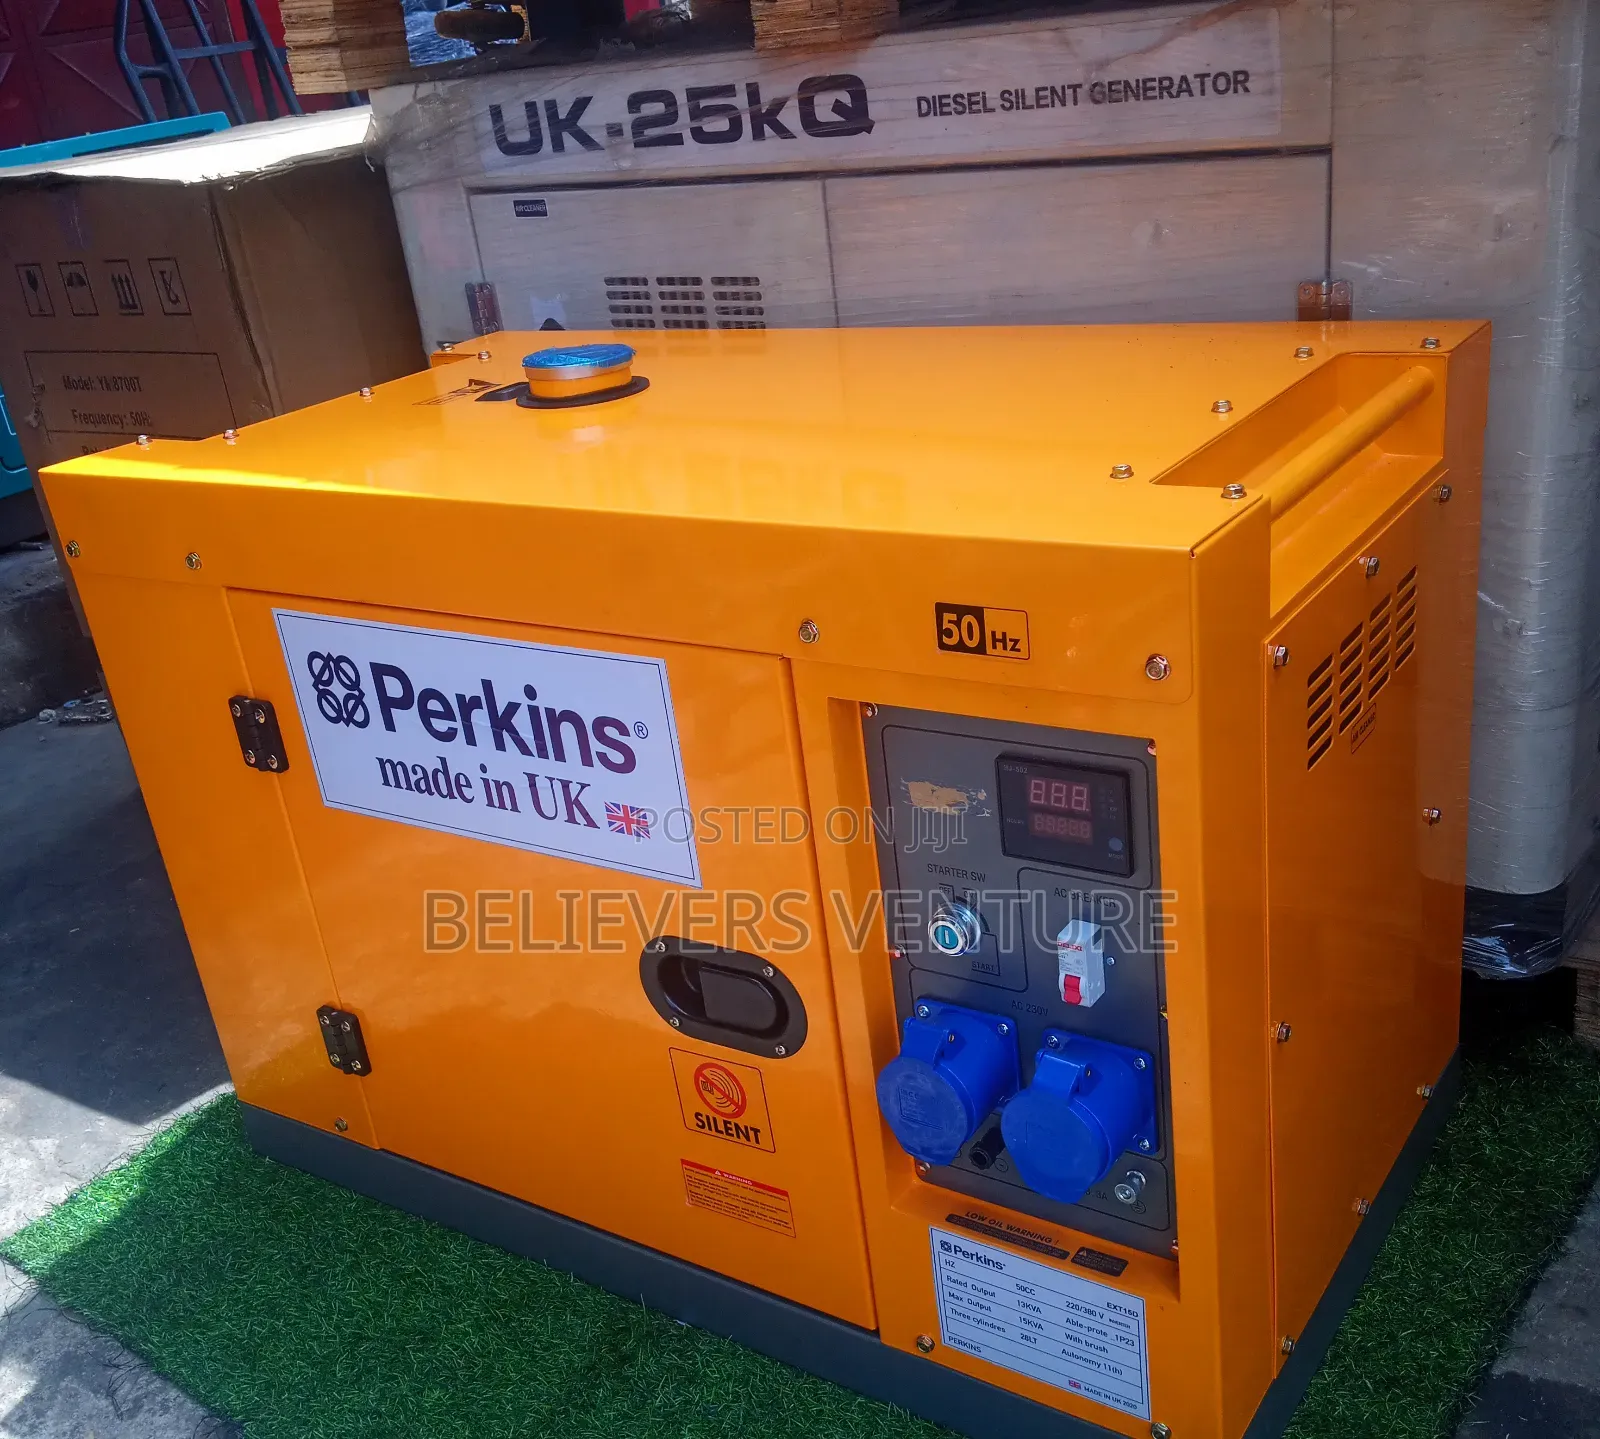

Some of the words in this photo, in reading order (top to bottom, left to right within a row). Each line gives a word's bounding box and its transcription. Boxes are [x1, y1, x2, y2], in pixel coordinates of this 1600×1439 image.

[917, 91, 996, 117] DIESEL
[999, 83, 1082, 111] SILENT
[1089, 69, 1251, 105] GENERATOR
[62, 375, 96, 391] Model:
[71, 408, 129, 429] Frequency:
[942, 612, 980, 648] 50
[990, 630, 1022, 653] Hz
[376, 756, 475, 804] made
[479, 763, 520, 814] in
[523, 771, 600, 830] UK
[927, 863, 968, 880] STARTER
[970, 871, 986, 883] SW
[1053, 887, 1067, 898] AC
[1070, 890, 1116, 908] BREAKER
[971, 960, 995, 972] START
[1011, 1000, 1024, 1011] AC
[1026, 1003, 1049, 1017] 230V
[694, 1111, 761, 1145] SILENT
[965, 1211, 988, 1222] LOW
[988, 1218, 1004, 1229] OIL
[1006, 1224, 1054, 1244] WARNING
[945, 1258, 956, 1268] HZ
[1098, 1312, 1105, 1320] V
[946, 1275, 968, 1288] Rated
[971, 1283, 996, 1298] Output
[1017, 1299, 1043, 1315] 13KVA
[948, 1291, 964, 1302] Max
[967, 1298, 992, 1313] Output
[1019, 1316, 1044, 1331] 15KVA
[1064, 1332, 1083, 1345] With
[1084, 1340, 1109, 1354] brush
[949, 1306, 971, 1320] Three
[972, 1316, 1006, 1333] cylindres
[1061, 1347, 1102, 1369] Autonomy
[948, 1335, 982, 1354] PERKINS
[1083, 1385, 1102, 1397] MADE
[1111, 1396, 1122, 1404] UK
[1122, 1400, 1138, 1410] 2020
